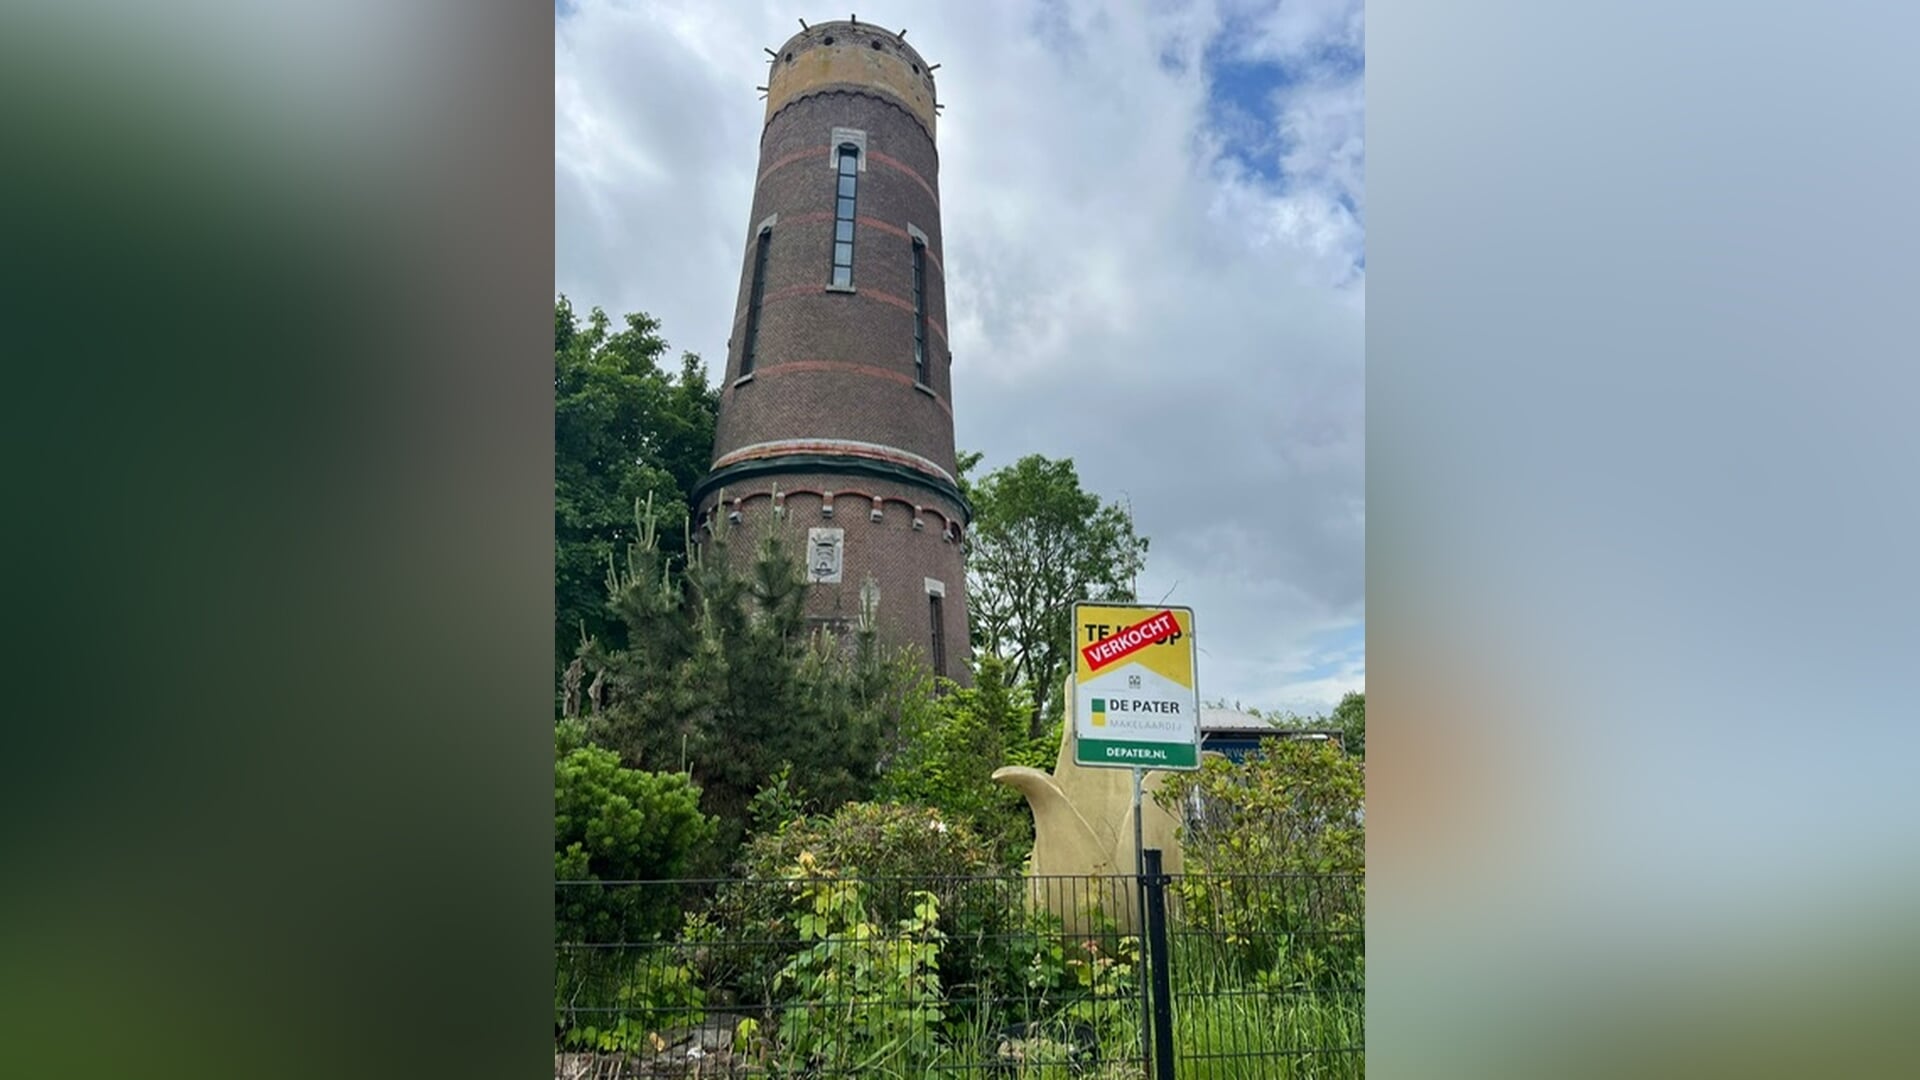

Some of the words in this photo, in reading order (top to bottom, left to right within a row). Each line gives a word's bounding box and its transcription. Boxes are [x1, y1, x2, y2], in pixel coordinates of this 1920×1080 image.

[1085, 624, 1110, 641] TE
[1088, 615, 1172, 663] VERKOCHT
[1109, 699, 1129, 712] DE
[1133, 700, 1180, 714] PATER
[1109, 719, 1182, 731] MAKELAARDIJ
[1106, 747, 1168, 759] DEPATER.NL
